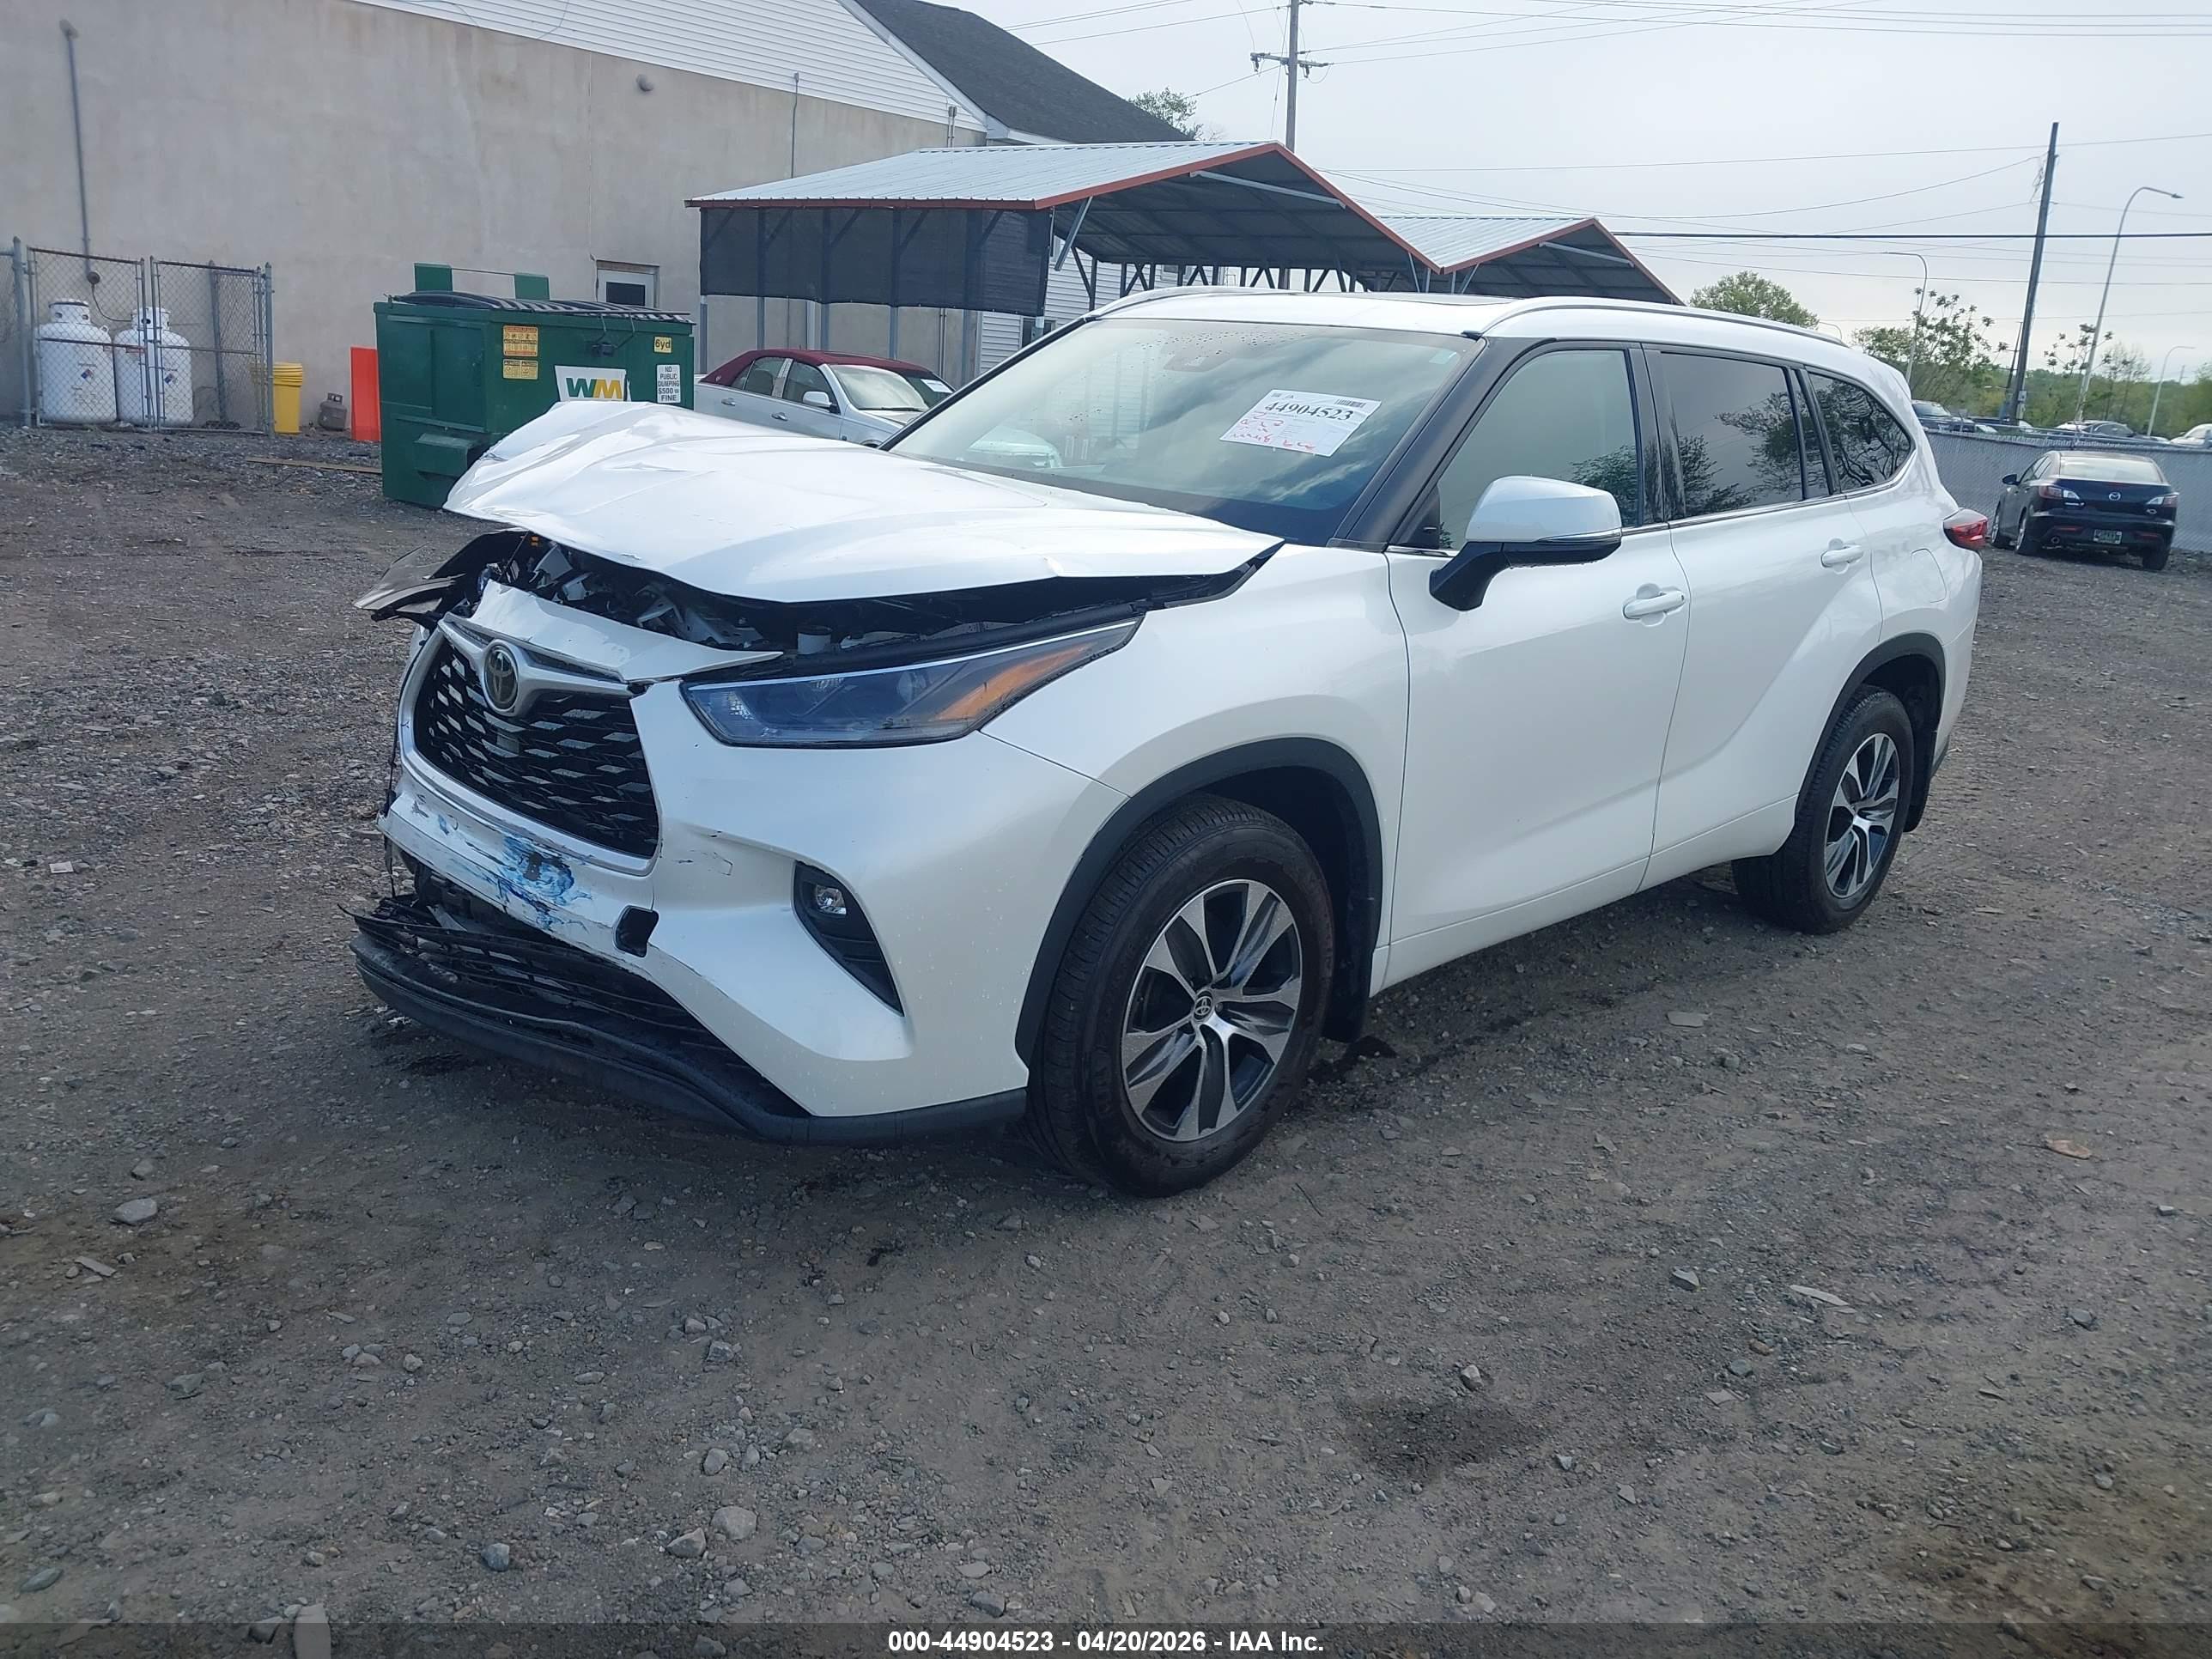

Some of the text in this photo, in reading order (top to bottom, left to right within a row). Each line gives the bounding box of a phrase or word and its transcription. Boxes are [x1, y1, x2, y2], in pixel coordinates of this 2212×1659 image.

[655, 339, 670, 349] 6yd
[566, 377, 623, 398] WM
[1265, 402, 1354, 421] 44904523
